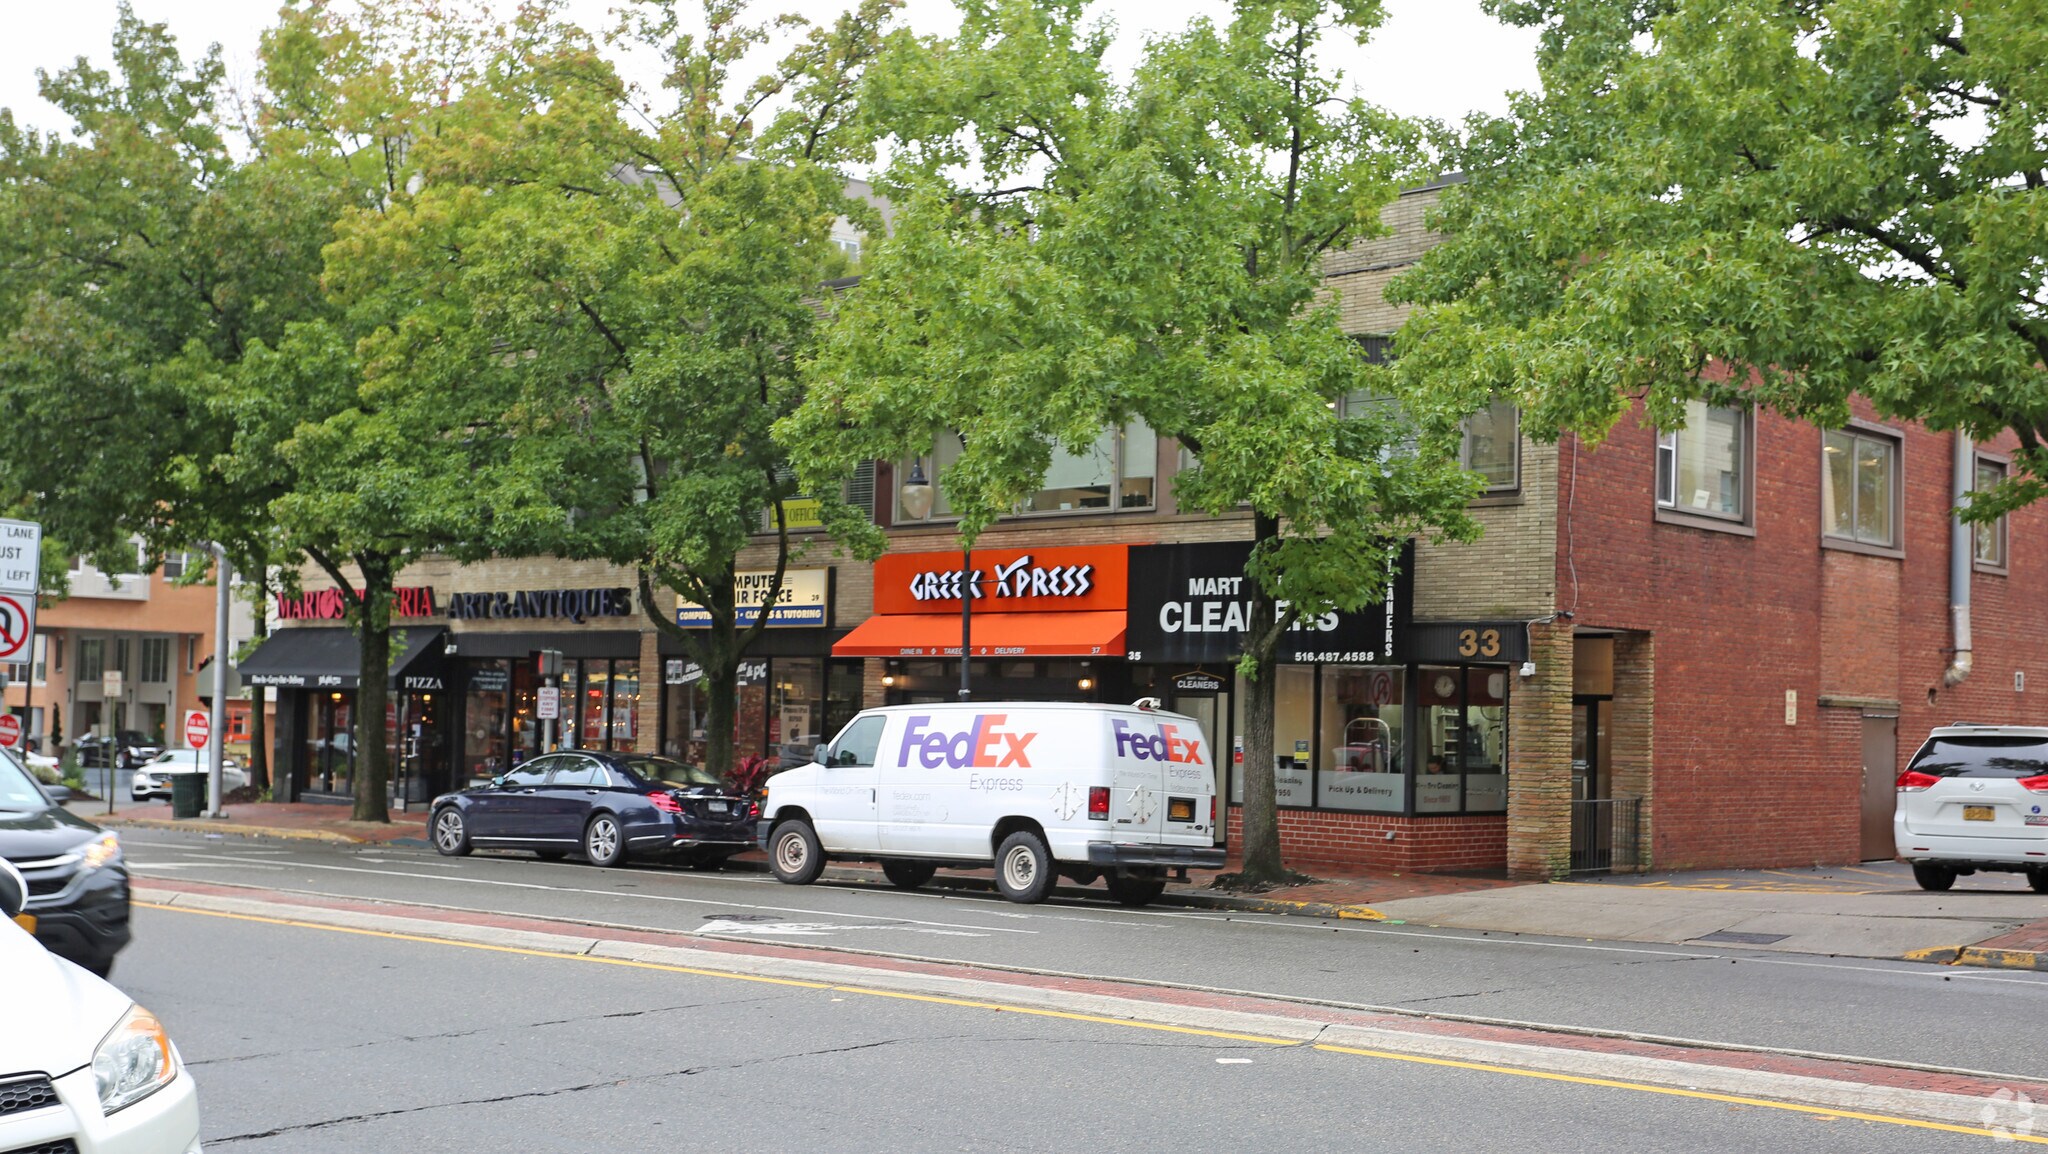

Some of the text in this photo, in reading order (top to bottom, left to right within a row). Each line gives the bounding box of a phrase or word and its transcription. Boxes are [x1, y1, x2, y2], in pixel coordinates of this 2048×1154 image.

[7, 527, 34, 539] LANE
[0, 546, 22, 559] UST
[7, 570, 31, 581] LEFT
[734, 575, 775, 589] MPUTE
[909, 555, 1093, 600] GREEK XPRESS
[1188, 577, 1243, 596] MART
[753, 589, 792, 603] FOCE
[511, 588, 632, 624] ANTIQUES
[783, 609, 822, 619] TUTORING
[1459, 629, 1500, 657] 33
[995, 647, 1025, 655] DELIVERY
[1092, 646, 1101, 654] 37
[1128, 651, 1141, 661] 35
[1295, 651, 1374, 662] 516.487.4588
[753, 662, 767, 681] PC
[404, 676, 443, 689] PIZZA
[1177, 680, 1219, 690] CLEANERS
[897, 714, 1038, 769] FedEx
[1112, 719, 1205, 765] FedEx
[1169, 765, 1201, 779] Express
[970, 773, 1023, 793] Express
[1328, 784, 1344, 793] Pick
[1345, 786, 1354, 795] Up
[1363, 786, 1393, 797] Delivery
